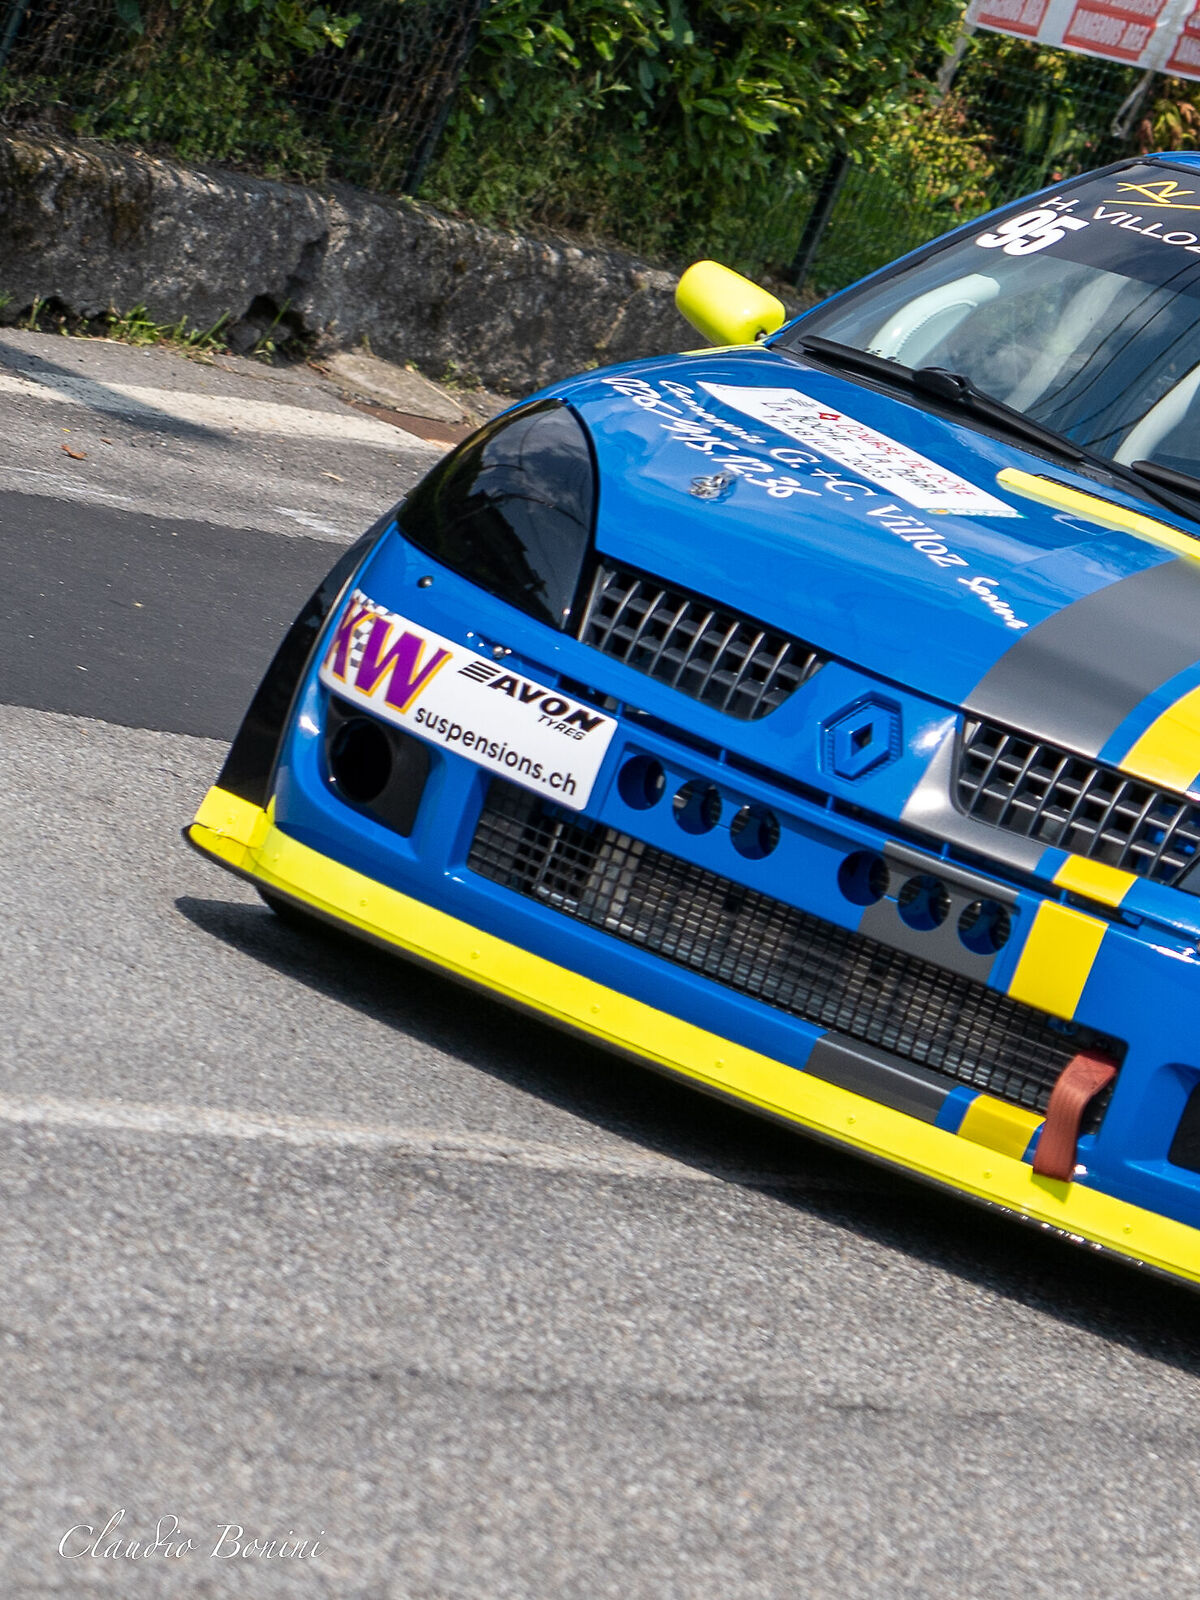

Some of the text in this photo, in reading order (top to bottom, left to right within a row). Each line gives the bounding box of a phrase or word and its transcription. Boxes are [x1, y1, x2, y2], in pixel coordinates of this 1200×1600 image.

[975, 208, 1090, 256] 95
[1039, 196, 1081, 213] H.
[866, 503, 970, 568] Villoz
[323, 596, 454, 715] KW
[484, 673, 606, 733] AVON
[537, 715, 588, 742] TYRES
[414, 706, 578, 797] suspensions.ch
